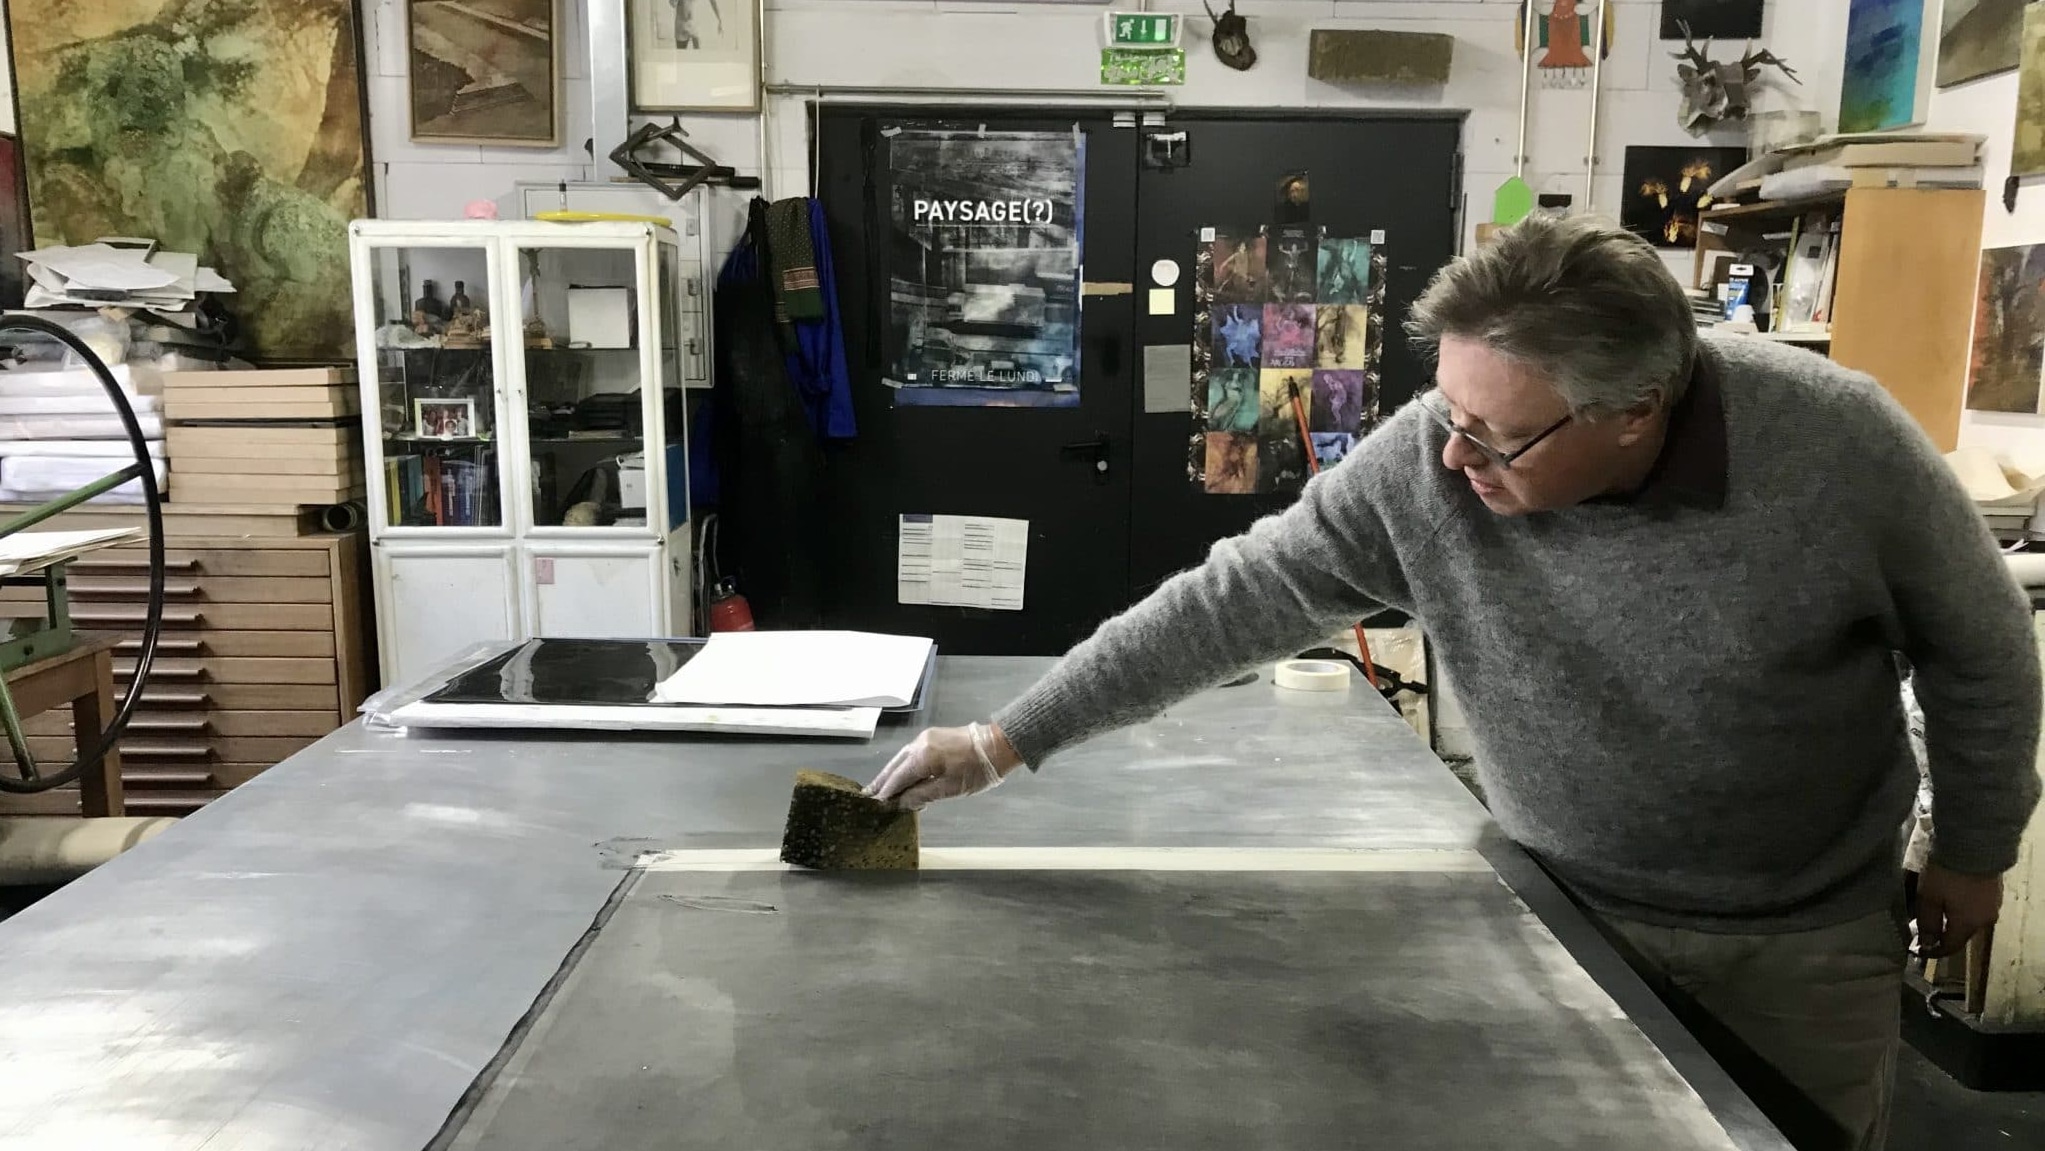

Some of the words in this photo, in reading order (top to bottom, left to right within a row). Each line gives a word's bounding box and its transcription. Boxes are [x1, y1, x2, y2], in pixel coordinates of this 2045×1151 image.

[914, 198, 1053, 224] PAYSAGE(?)
[979, 370, 995, 382] LE
[1002, 370, 1041, 383] LUNDI
